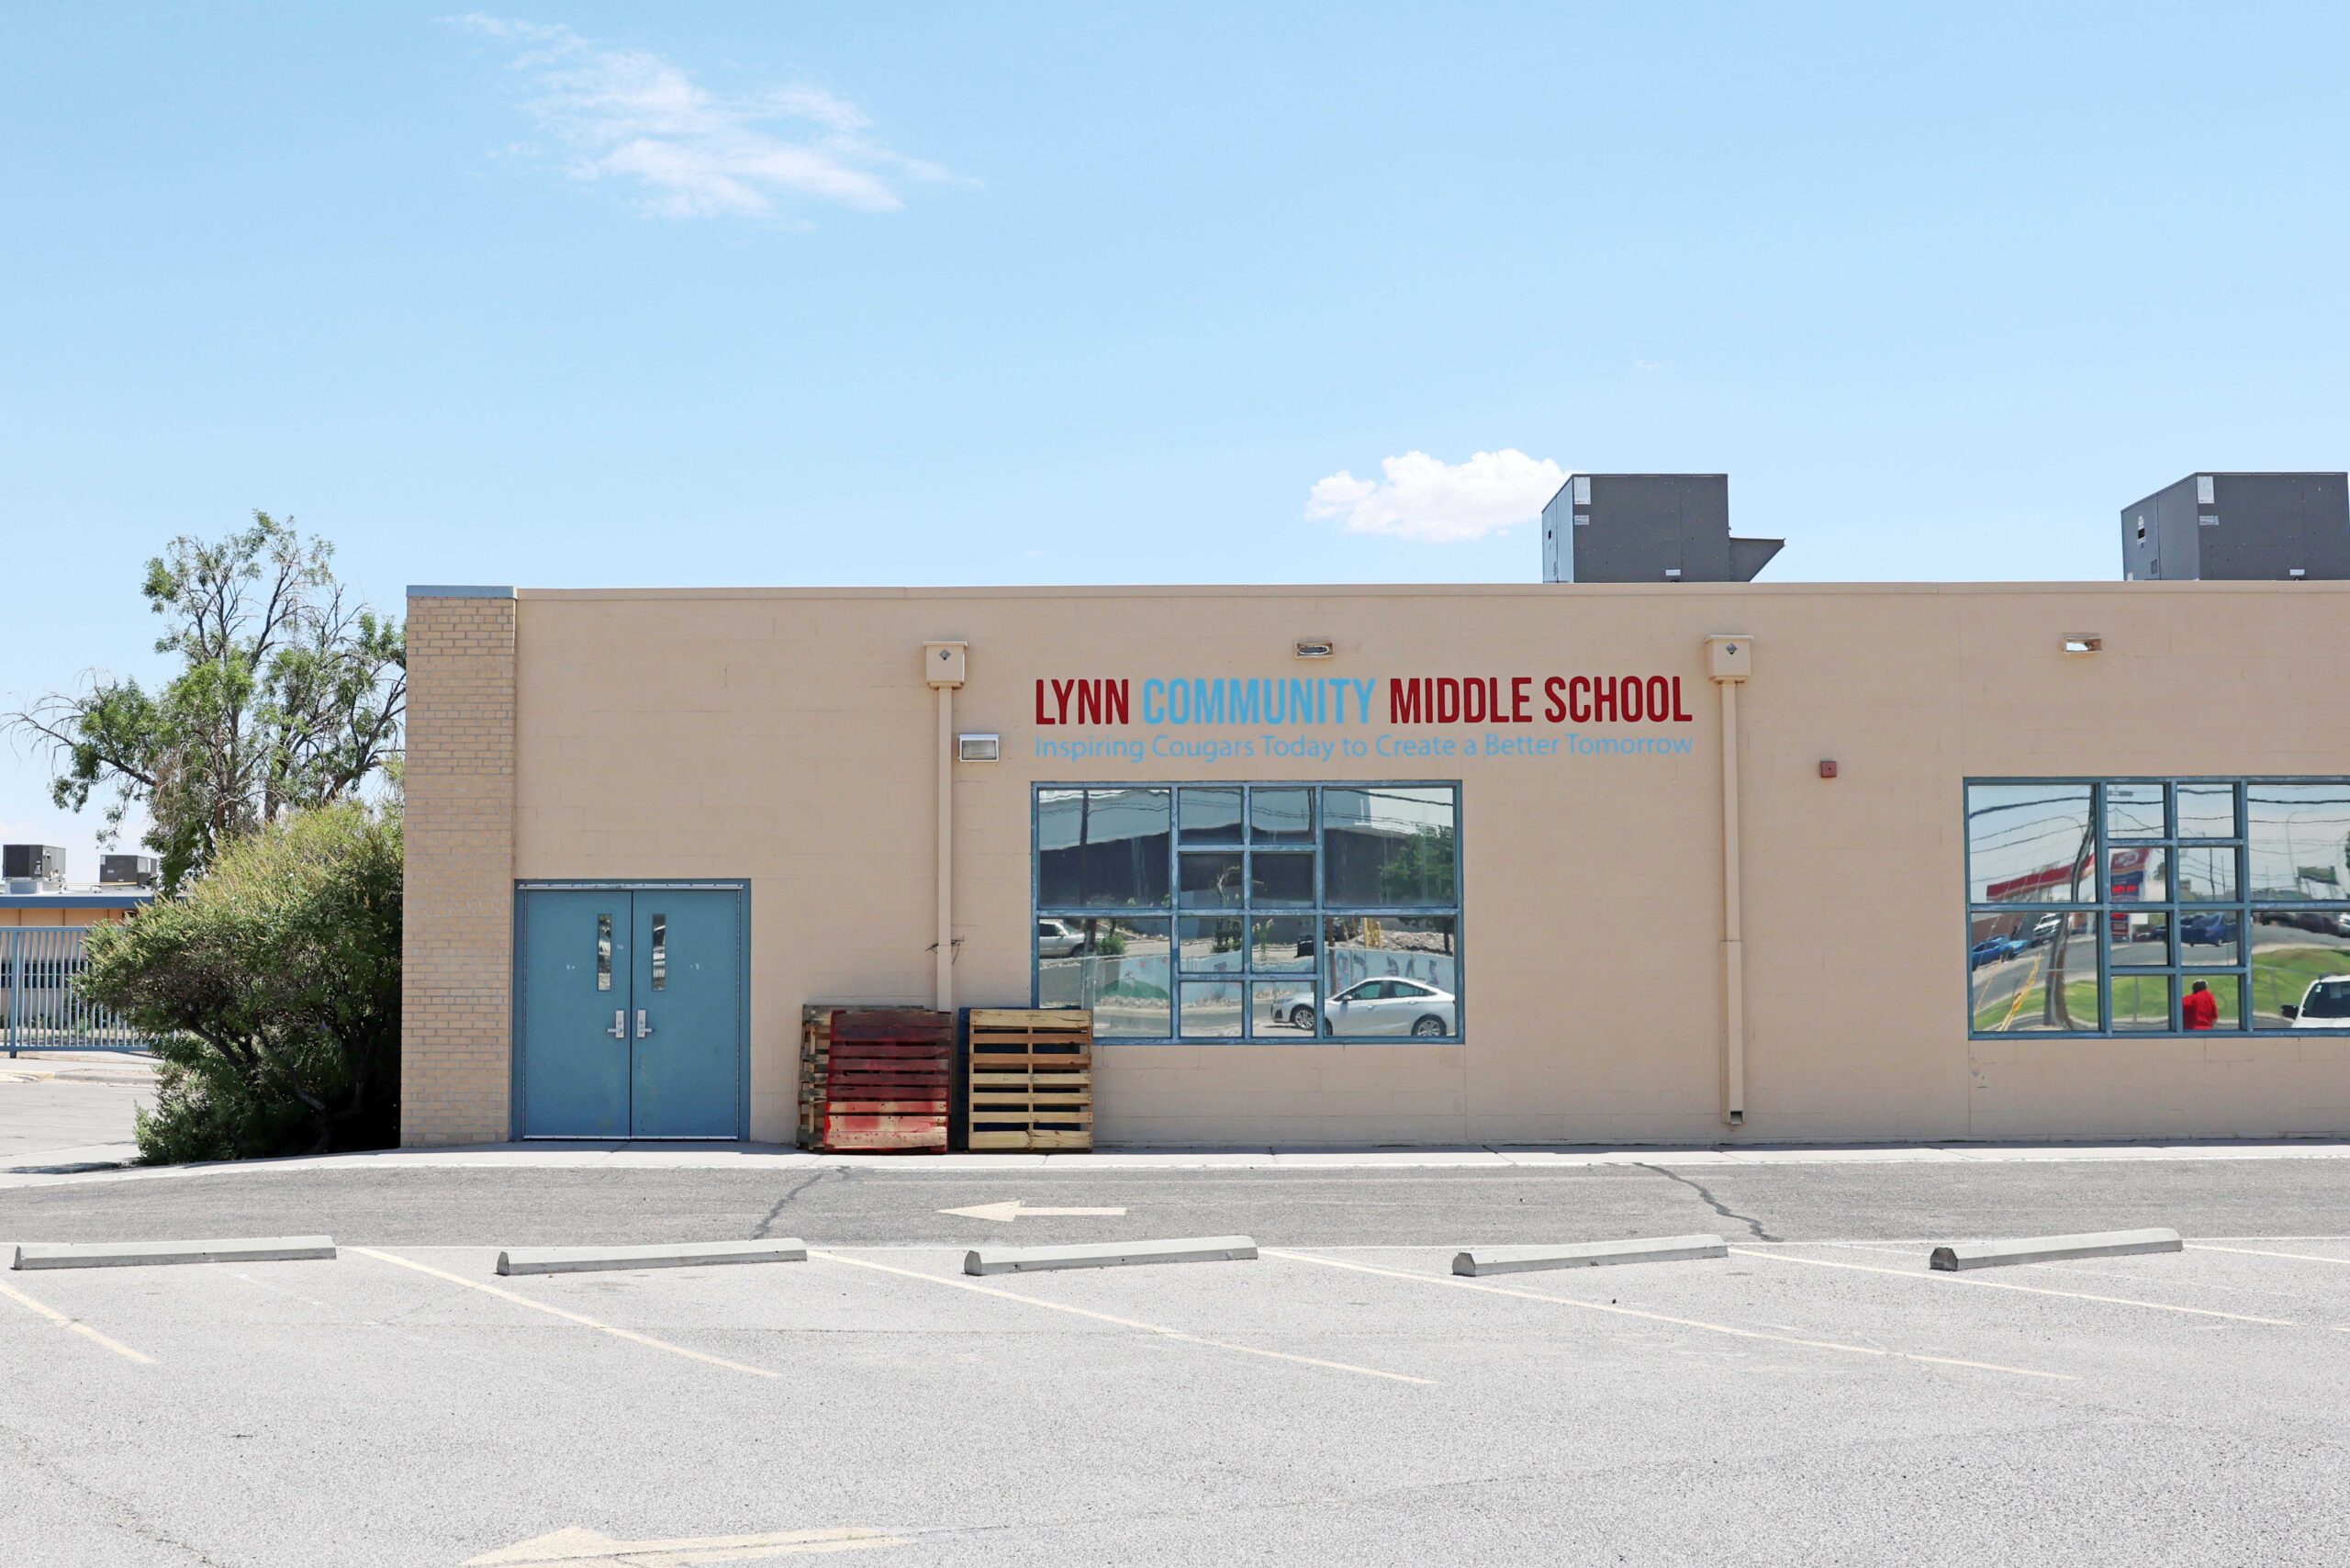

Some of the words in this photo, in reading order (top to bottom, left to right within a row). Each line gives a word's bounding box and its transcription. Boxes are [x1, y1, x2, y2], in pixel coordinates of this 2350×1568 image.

[1036, 679, 1129, 725] LYNN
[1143, 678, 1377, 725] COMMUNITY
[1391, 677, 1533, 723] MIDDLE
[1545, 676, 1693, 722] SCHOOL
[1035, 735, 1145, 763] Inspiring
[1152, 734, 1254, 763] Cougars
[1261, 735, 1336, 763] Today
[1342, 738, 1368, 757] to
[1375, 734, 1457, 757] Create
[1463, 740, 1478, 756] a
[1484, 734, 1561, 756] Better
[1566, 733, 1694, 756] Tomorrow
